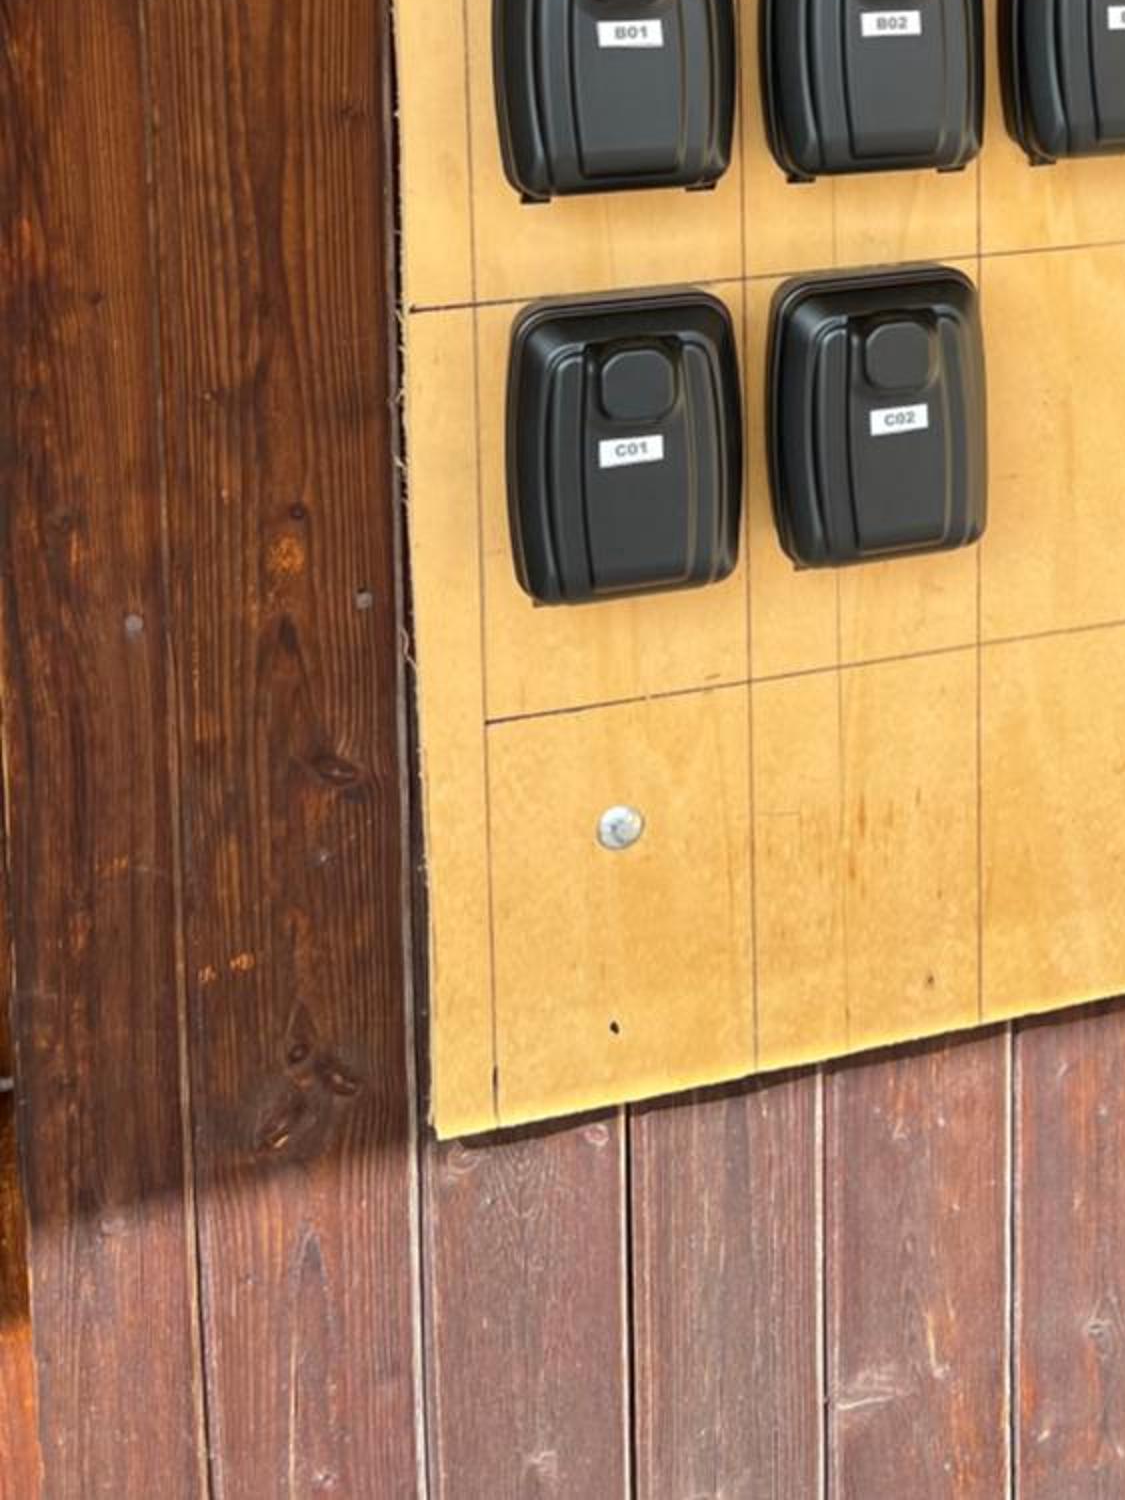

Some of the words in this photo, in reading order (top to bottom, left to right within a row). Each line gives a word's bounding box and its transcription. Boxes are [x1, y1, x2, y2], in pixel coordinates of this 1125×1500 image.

[876, 17, 907, 30] B02
[614, 26, 647, 39] B01
[883, 411, 914, 426] C02
[614, 442, 647, 457] C01
